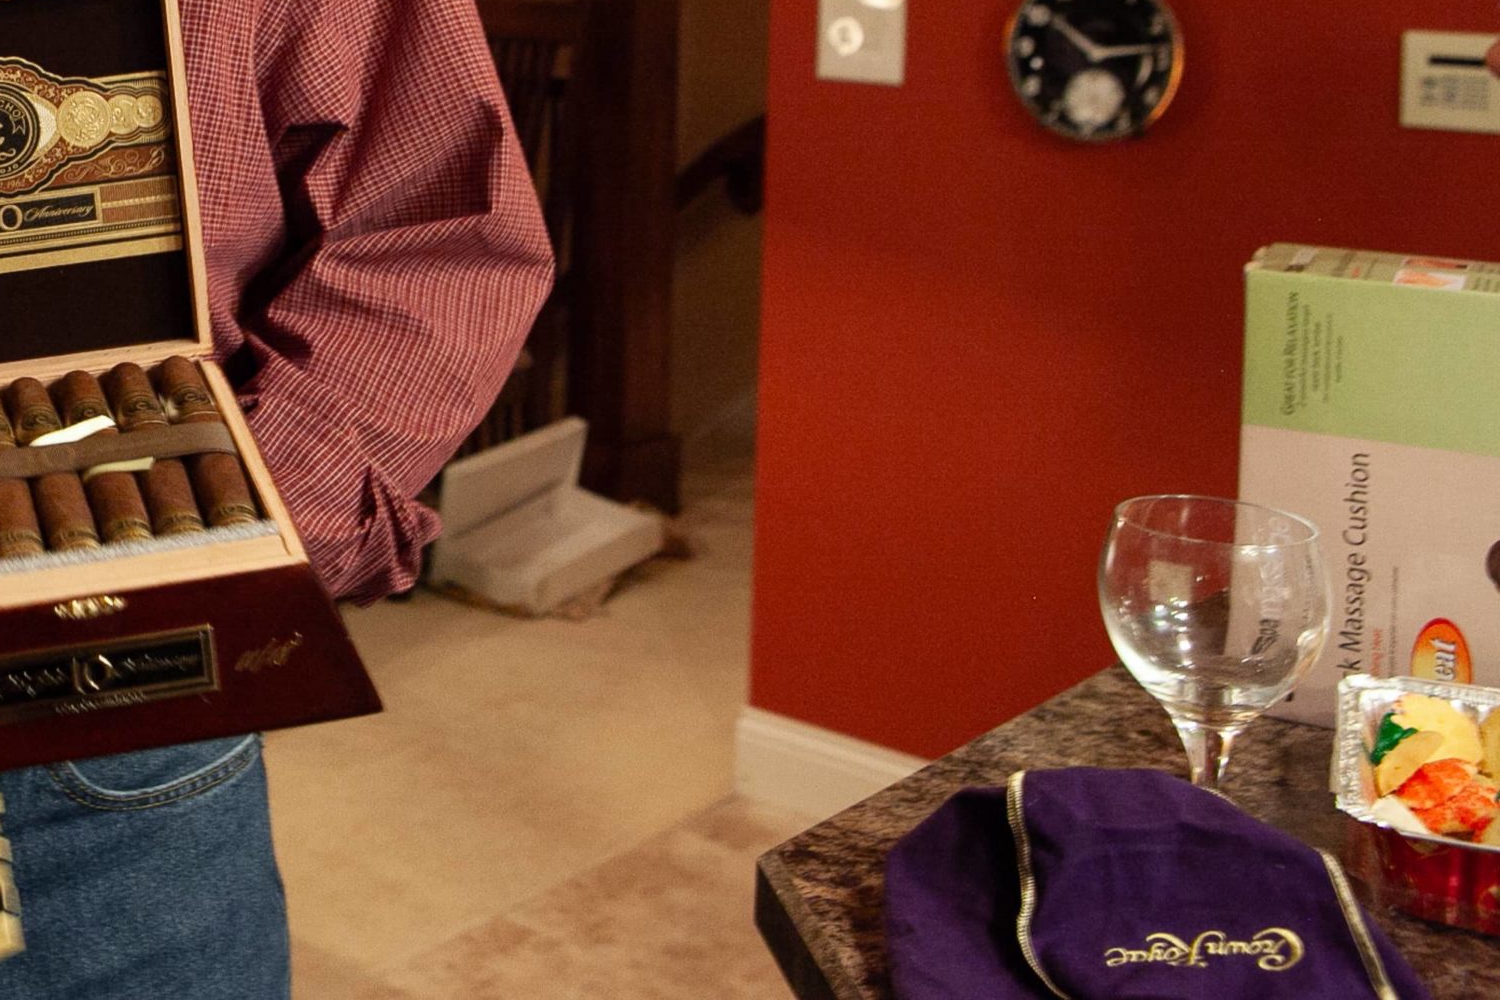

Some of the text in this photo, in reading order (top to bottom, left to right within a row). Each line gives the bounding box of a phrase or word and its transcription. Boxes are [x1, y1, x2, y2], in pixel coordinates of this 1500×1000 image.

[23, 204, 94, 222] Anniversary
[1342, 452, 1371, 547] Cushion
[1339, 552, 1372, 654] Massage
[1429, 638, 1457, 681] eat
[1204, 927, 1306, 971] Crown
